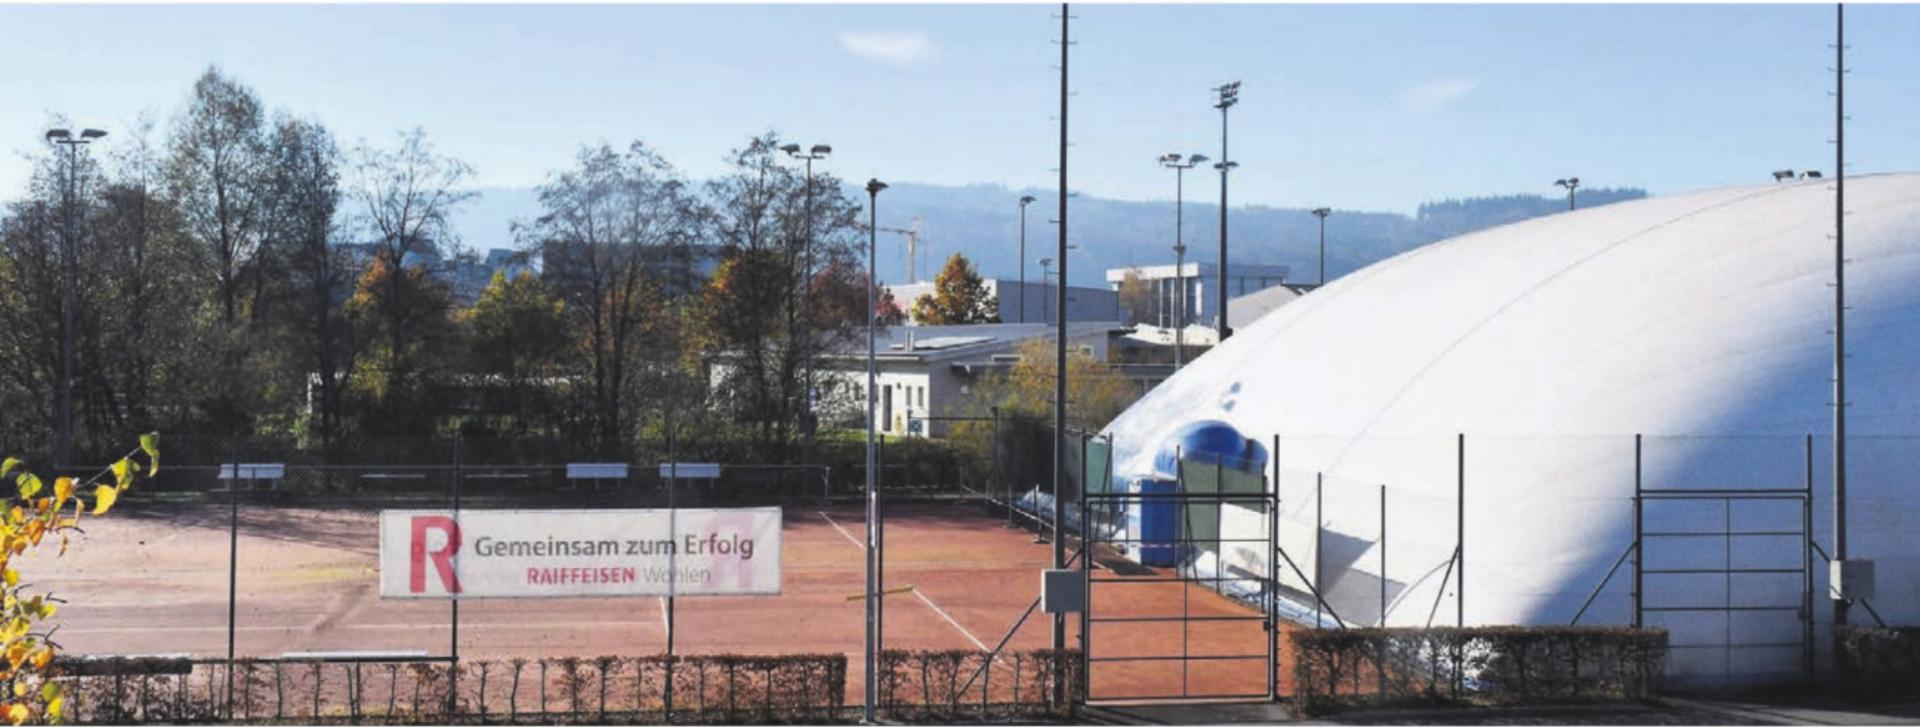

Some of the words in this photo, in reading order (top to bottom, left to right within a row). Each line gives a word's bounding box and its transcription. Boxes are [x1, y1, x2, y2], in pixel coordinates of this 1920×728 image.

[410, 515, 463, 594] R
[474, 534, 619, 557] Gemeinsam
[625, 539, 677, 556] zum
[684, 532, 754, 561] Erfolg
[526, 566, 636, 585] RAIFFEISEN
[643, 563, 712, 584] Wohlen
